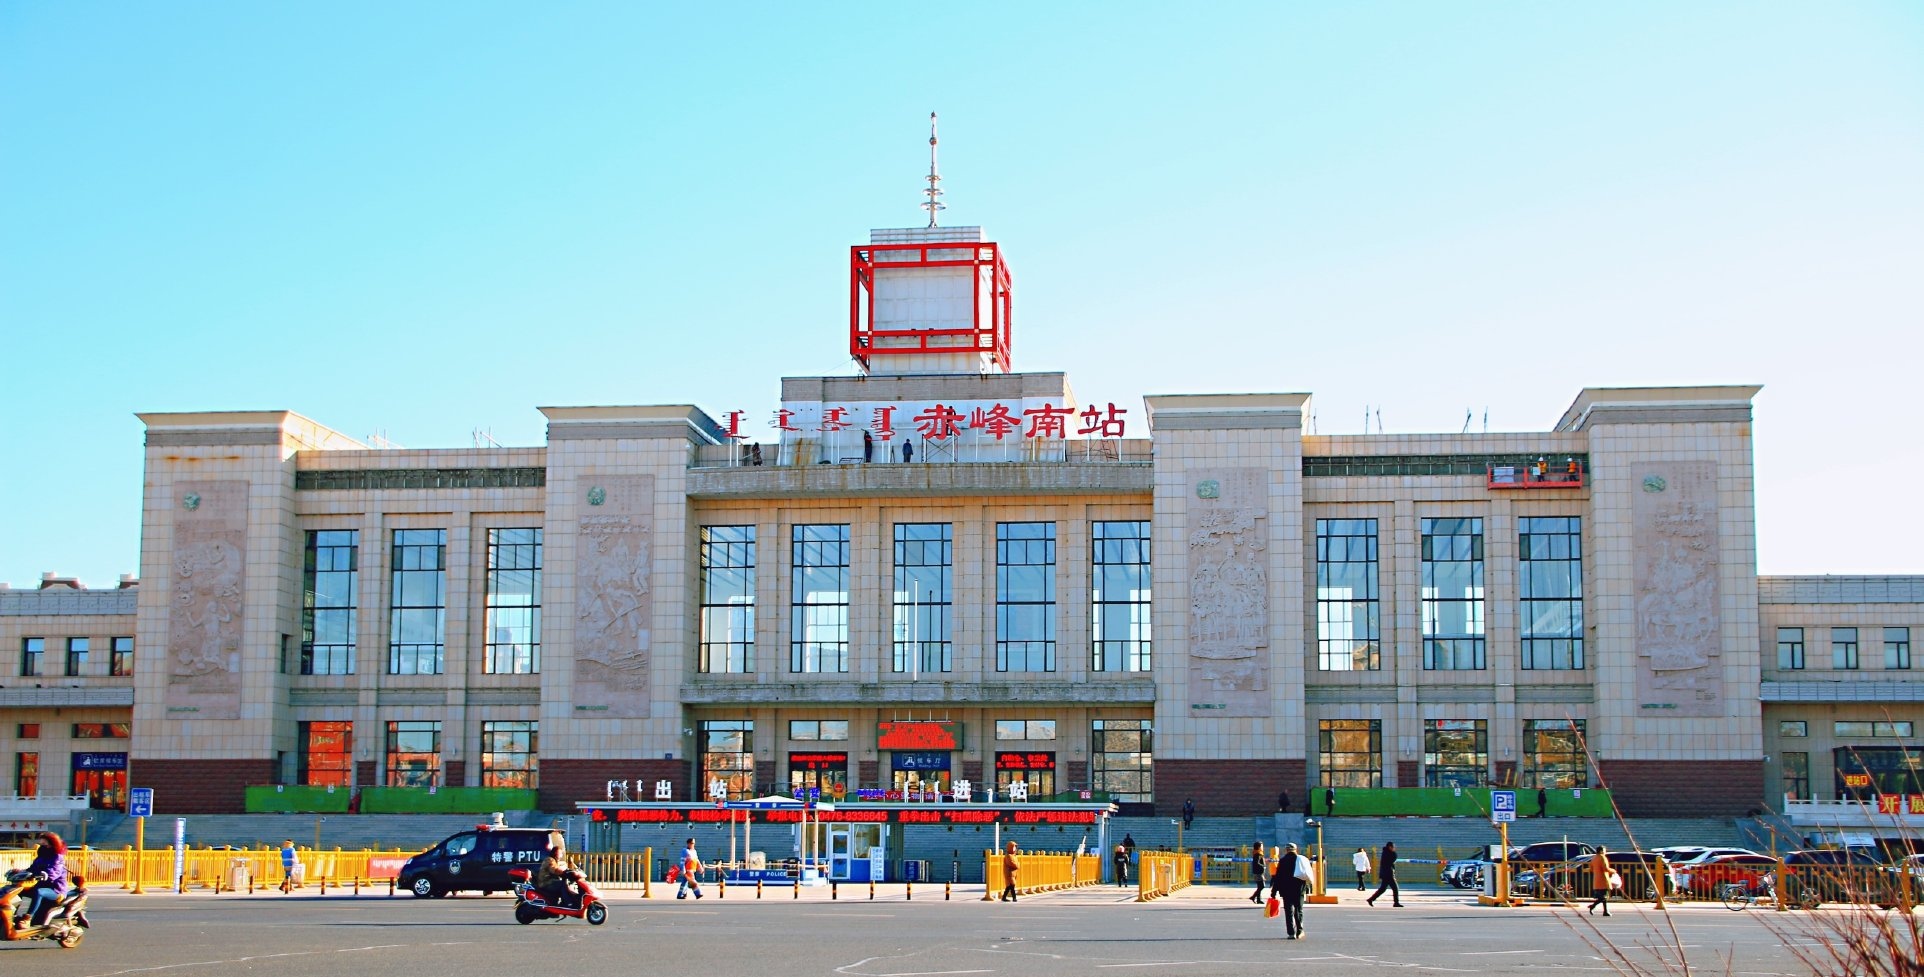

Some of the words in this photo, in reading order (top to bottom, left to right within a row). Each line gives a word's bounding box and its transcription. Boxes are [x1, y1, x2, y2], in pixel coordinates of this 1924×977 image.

[912, 402, 1128, 440] 赤峰南站
[1846, 775, 1867, 786] 进站口
[656, 778, 727, 799] 出站
[953, 780, 1028, 800] 进站
[1497, 812, 1511, 820] 出口
[491, 851, 514, 863] 特警
[518, 850, 541, 862] PTU
[766, 870, 788, 878] POLICE
